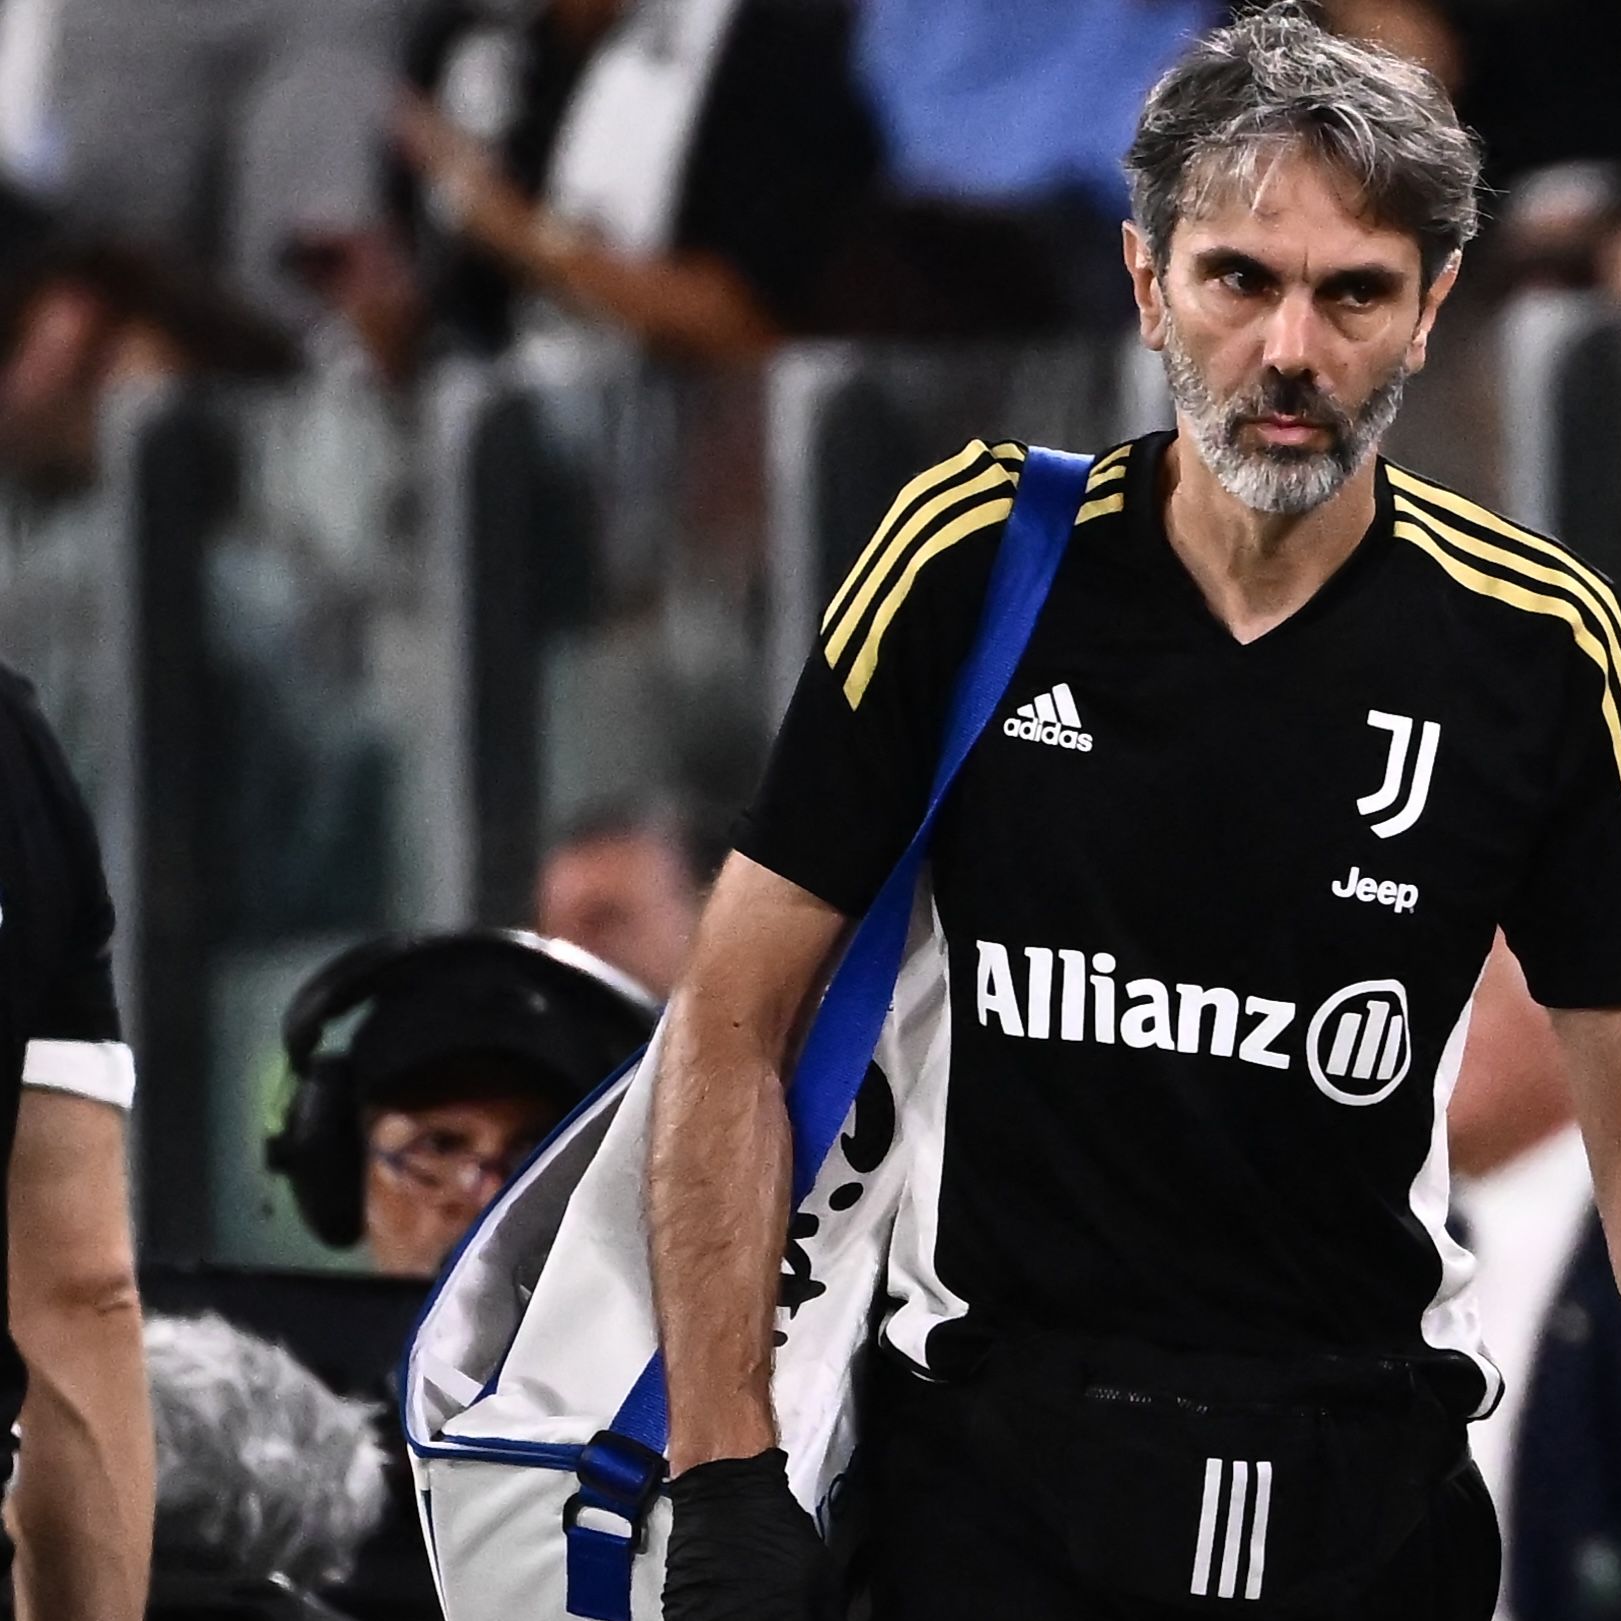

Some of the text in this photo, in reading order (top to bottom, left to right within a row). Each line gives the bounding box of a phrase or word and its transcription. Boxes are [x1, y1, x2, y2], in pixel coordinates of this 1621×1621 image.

[1003, 715, 1094, 753] adidas
[1331, 866, 1418, 914] Jeep
[976, 939, 1296, 1070] Allianz
